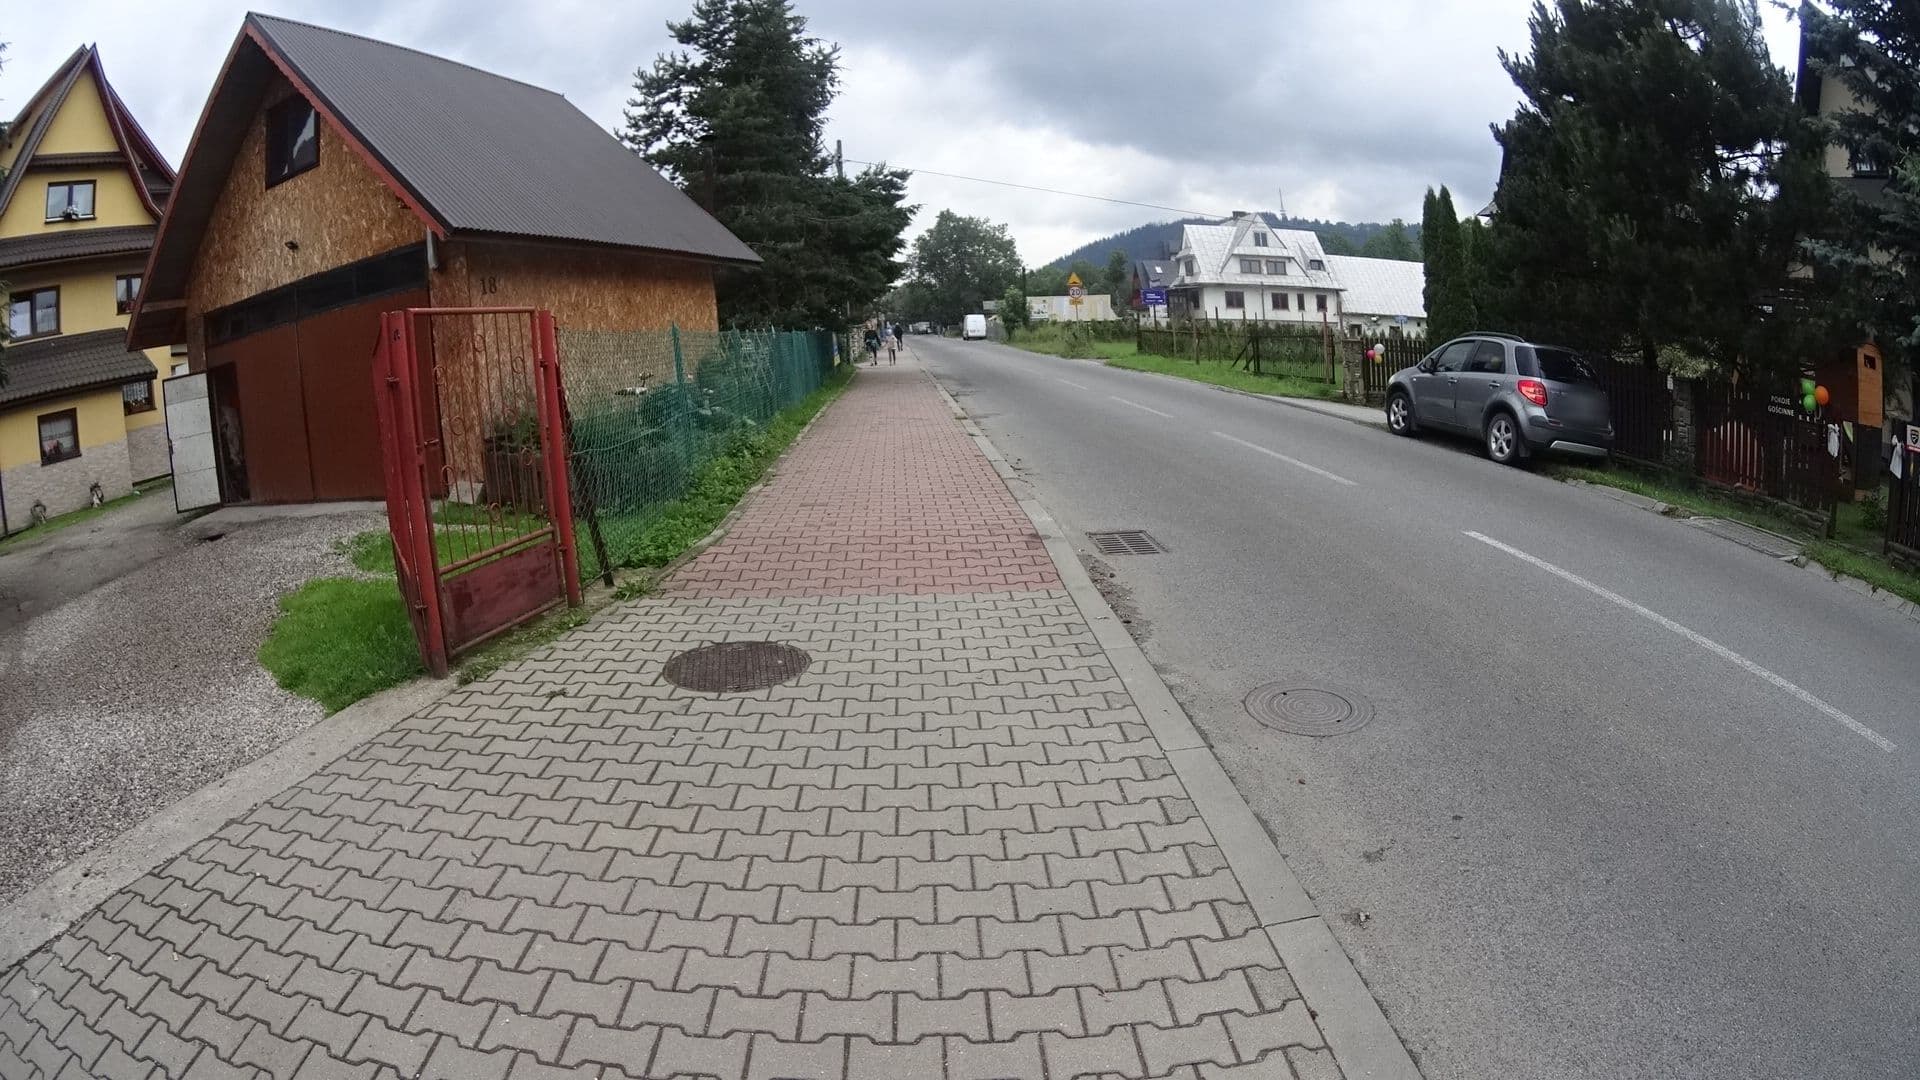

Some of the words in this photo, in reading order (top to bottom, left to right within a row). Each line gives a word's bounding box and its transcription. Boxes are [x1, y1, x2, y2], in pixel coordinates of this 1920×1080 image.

[480, 276, 497, 295] 18
[1070, 288, 1081, 296] 20
[1770, 395, 1791, 405] POKOJE
[1767, 405, 1794, 416] GOŚCINNE
